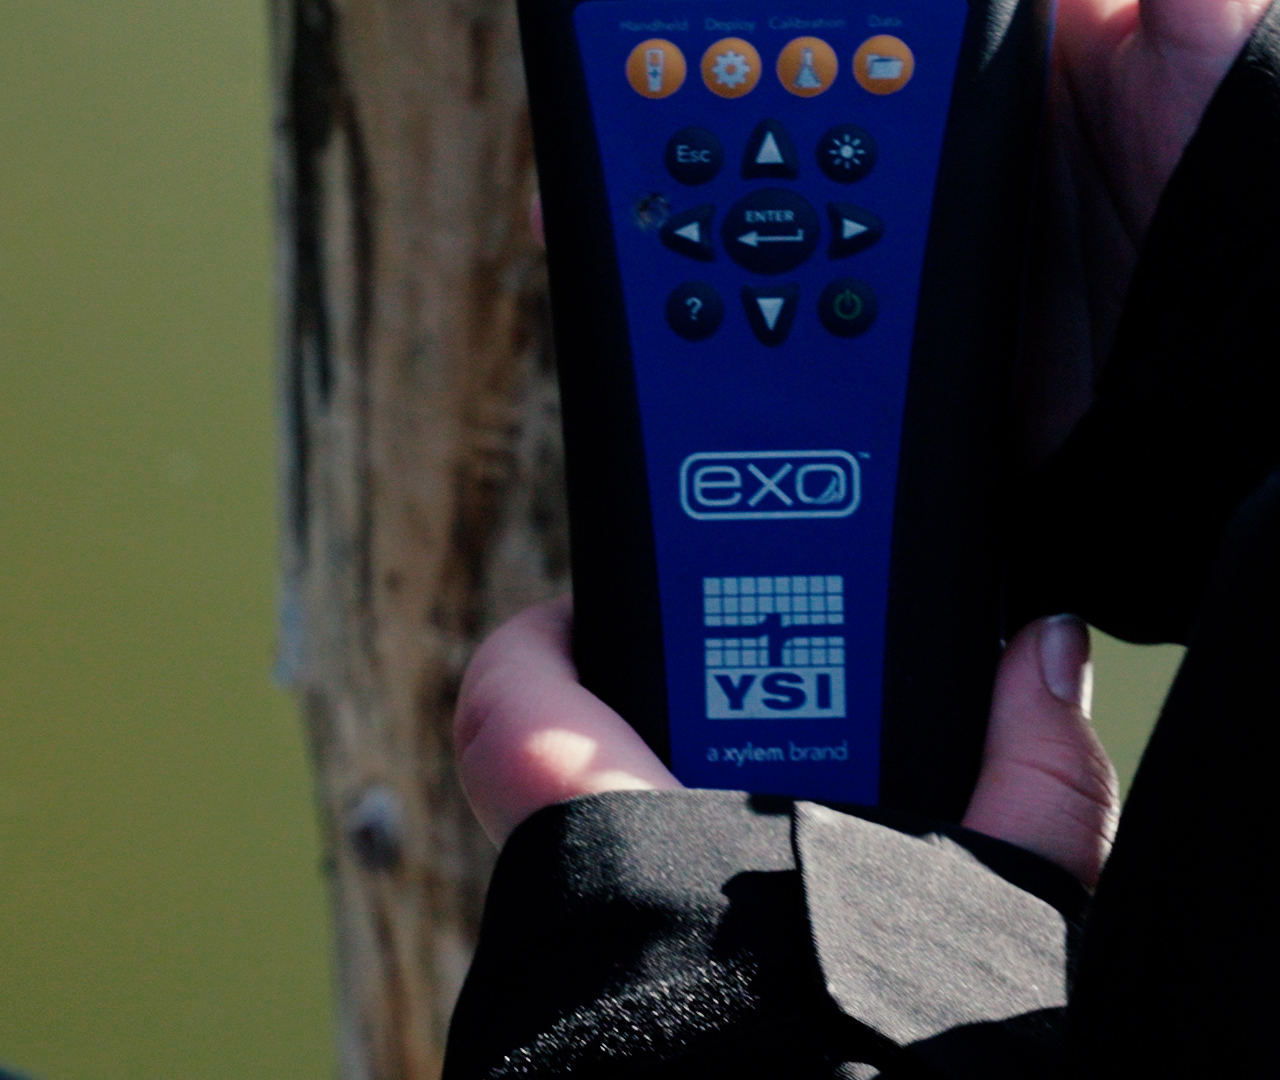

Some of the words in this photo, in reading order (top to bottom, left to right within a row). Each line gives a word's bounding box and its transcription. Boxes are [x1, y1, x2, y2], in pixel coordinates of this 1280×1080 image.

[768, 16, 847, 30] Calibration
[867, 14, 903, 27] Data
[676, 145, 711, 163] Esc
[745, 210, 795, 223] ENTER
[713, 672, 833, 711] YSI
[706, 746, 718, 762] a
[722, 742, 785, 767] xylem
[789, 740, 849, 762] brand
